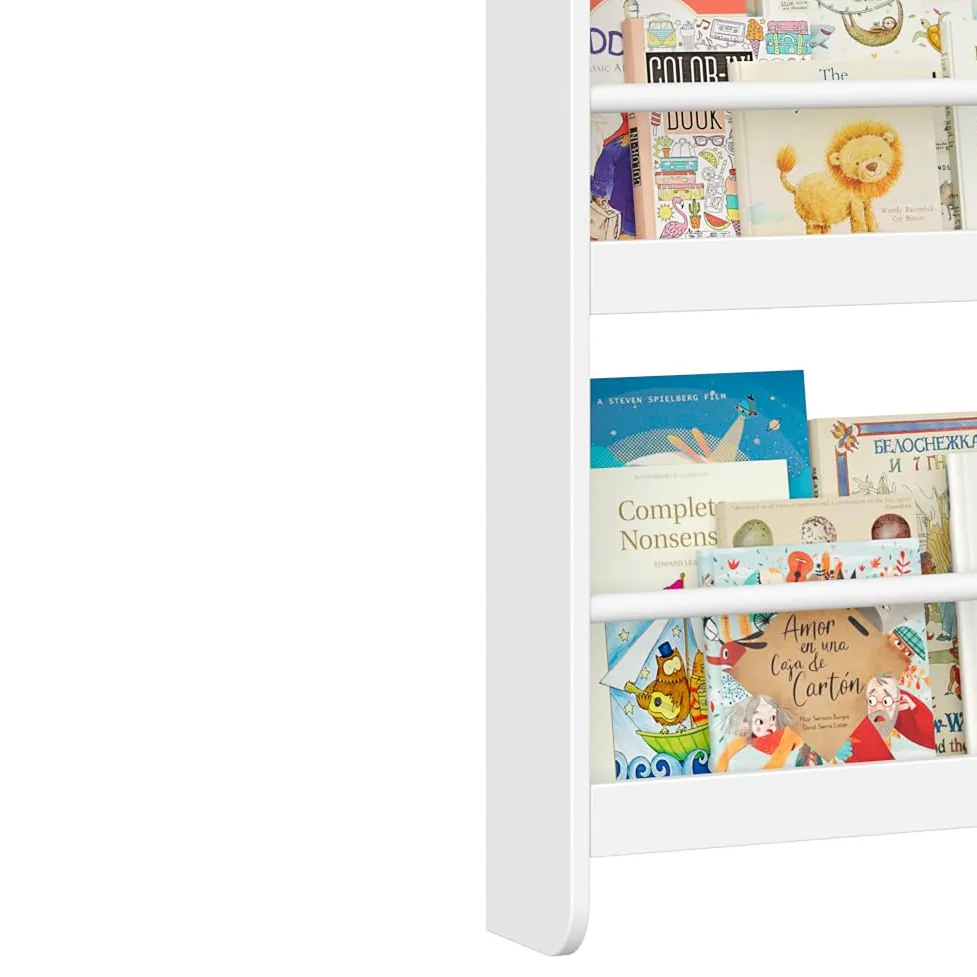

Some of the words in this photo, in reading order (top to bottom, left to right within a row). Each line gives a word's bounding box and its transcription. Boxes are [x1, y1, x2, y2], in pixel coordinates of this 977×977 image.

[819, 67, 849, 81] The
[608, 396, 642, 405] STEVEN
[648, 393, 699, 403] SPIELBERG
[888, 456, 903, 473] И
[913, 456, 921, 471] 7
[618, 496, 716, 525] Complet
[619, 529, 718, 551] Nonsens
[780, 615, 835, 643] Amor
[800, 641, 817, 655] en
[821, 639, 850, 652] una
[771, 654, 803, 682] Caja
[808, 653, 826, 673] de
[792, 671, 865, 708] Cartón
